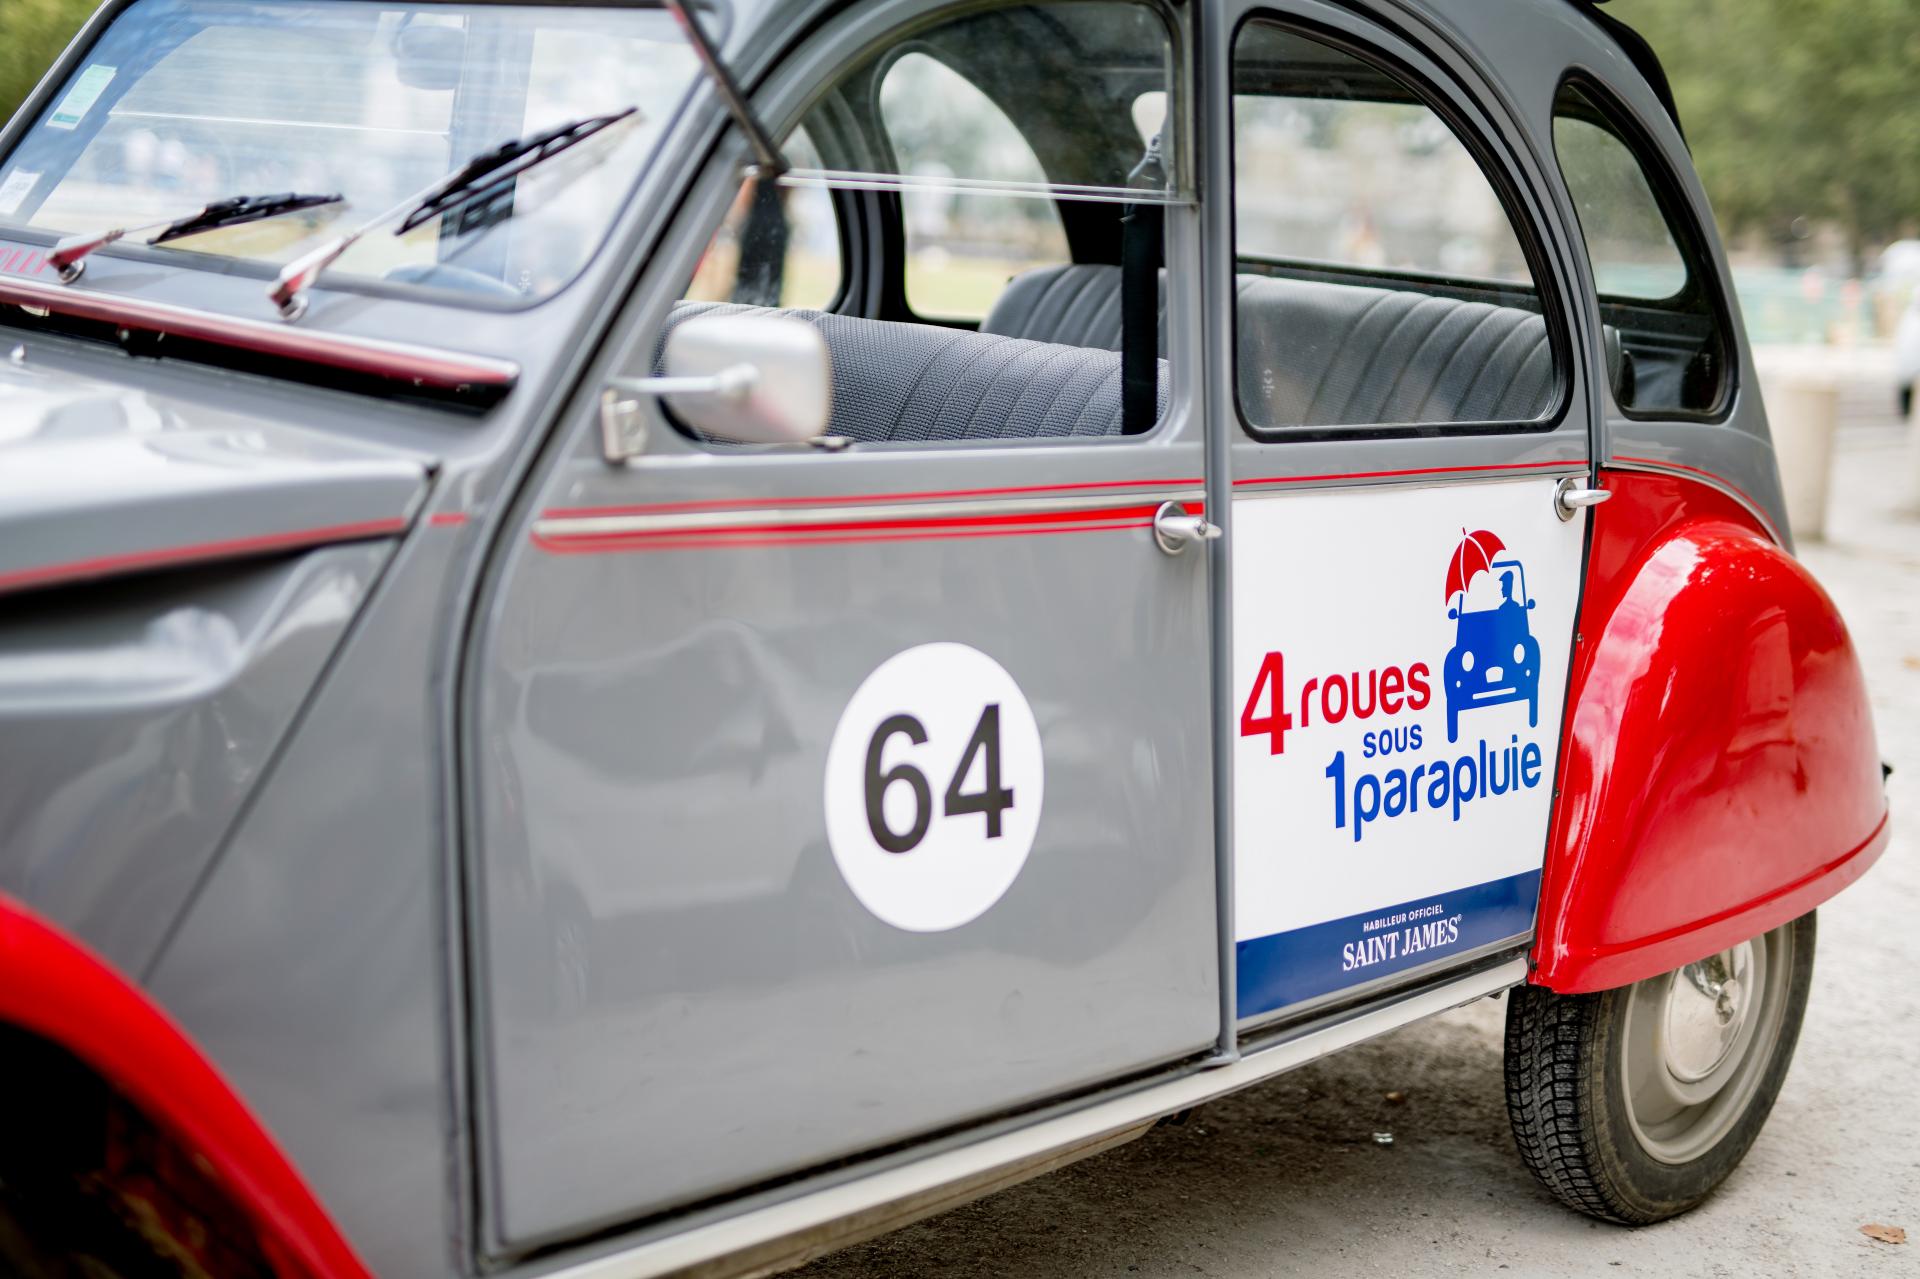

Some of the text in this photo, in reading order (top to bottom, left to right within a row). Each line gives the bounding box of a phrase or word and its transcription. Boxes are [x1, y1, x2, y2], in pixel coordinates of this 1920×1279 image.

[1241, 651, 1432, 756] 4 roues
[1363, 723, 1423, 759] sous
[864, 703, 1014, 854] 64
[1354, 734, 1542, 842] parapluie
[1342, 931, 1400, 972] SAINT
[1363, 904, 1444, 932] HABILLEUR OFFICIEL
